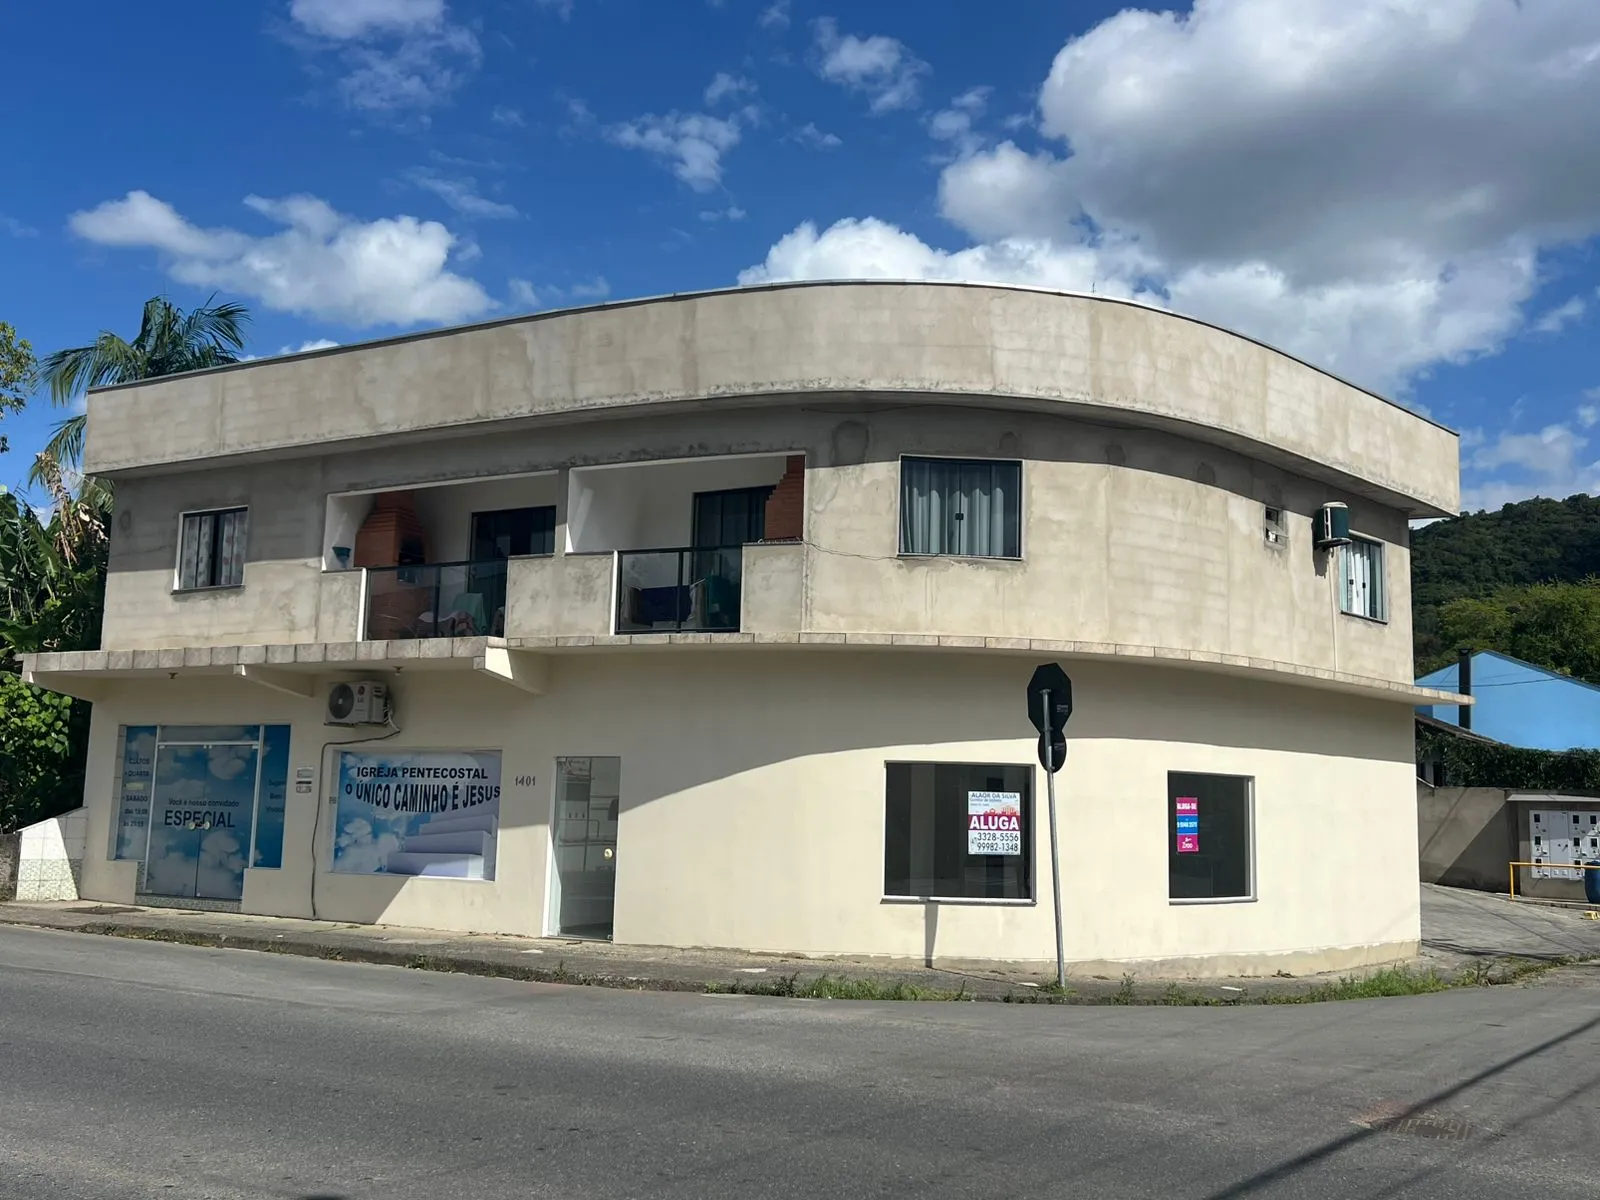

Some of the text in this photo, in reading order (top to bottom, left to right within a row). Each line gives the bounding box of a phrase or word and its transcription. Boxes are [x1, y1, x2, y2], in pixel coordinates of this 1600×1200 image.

[357, 767, 488, 779] IGREJA PENTECOSTAL
[515, 775, 536, 787] 1401
[345, 779, 501, 813] O ÚNICO CAMINHO É JESUS
[208, 799, 239, 807] convidado
[164, 810, 236, 828] ESPECIAL
[969, 815, 1019, 830] ALUGA
[977, 832, 1019, 842] 3328-5556
